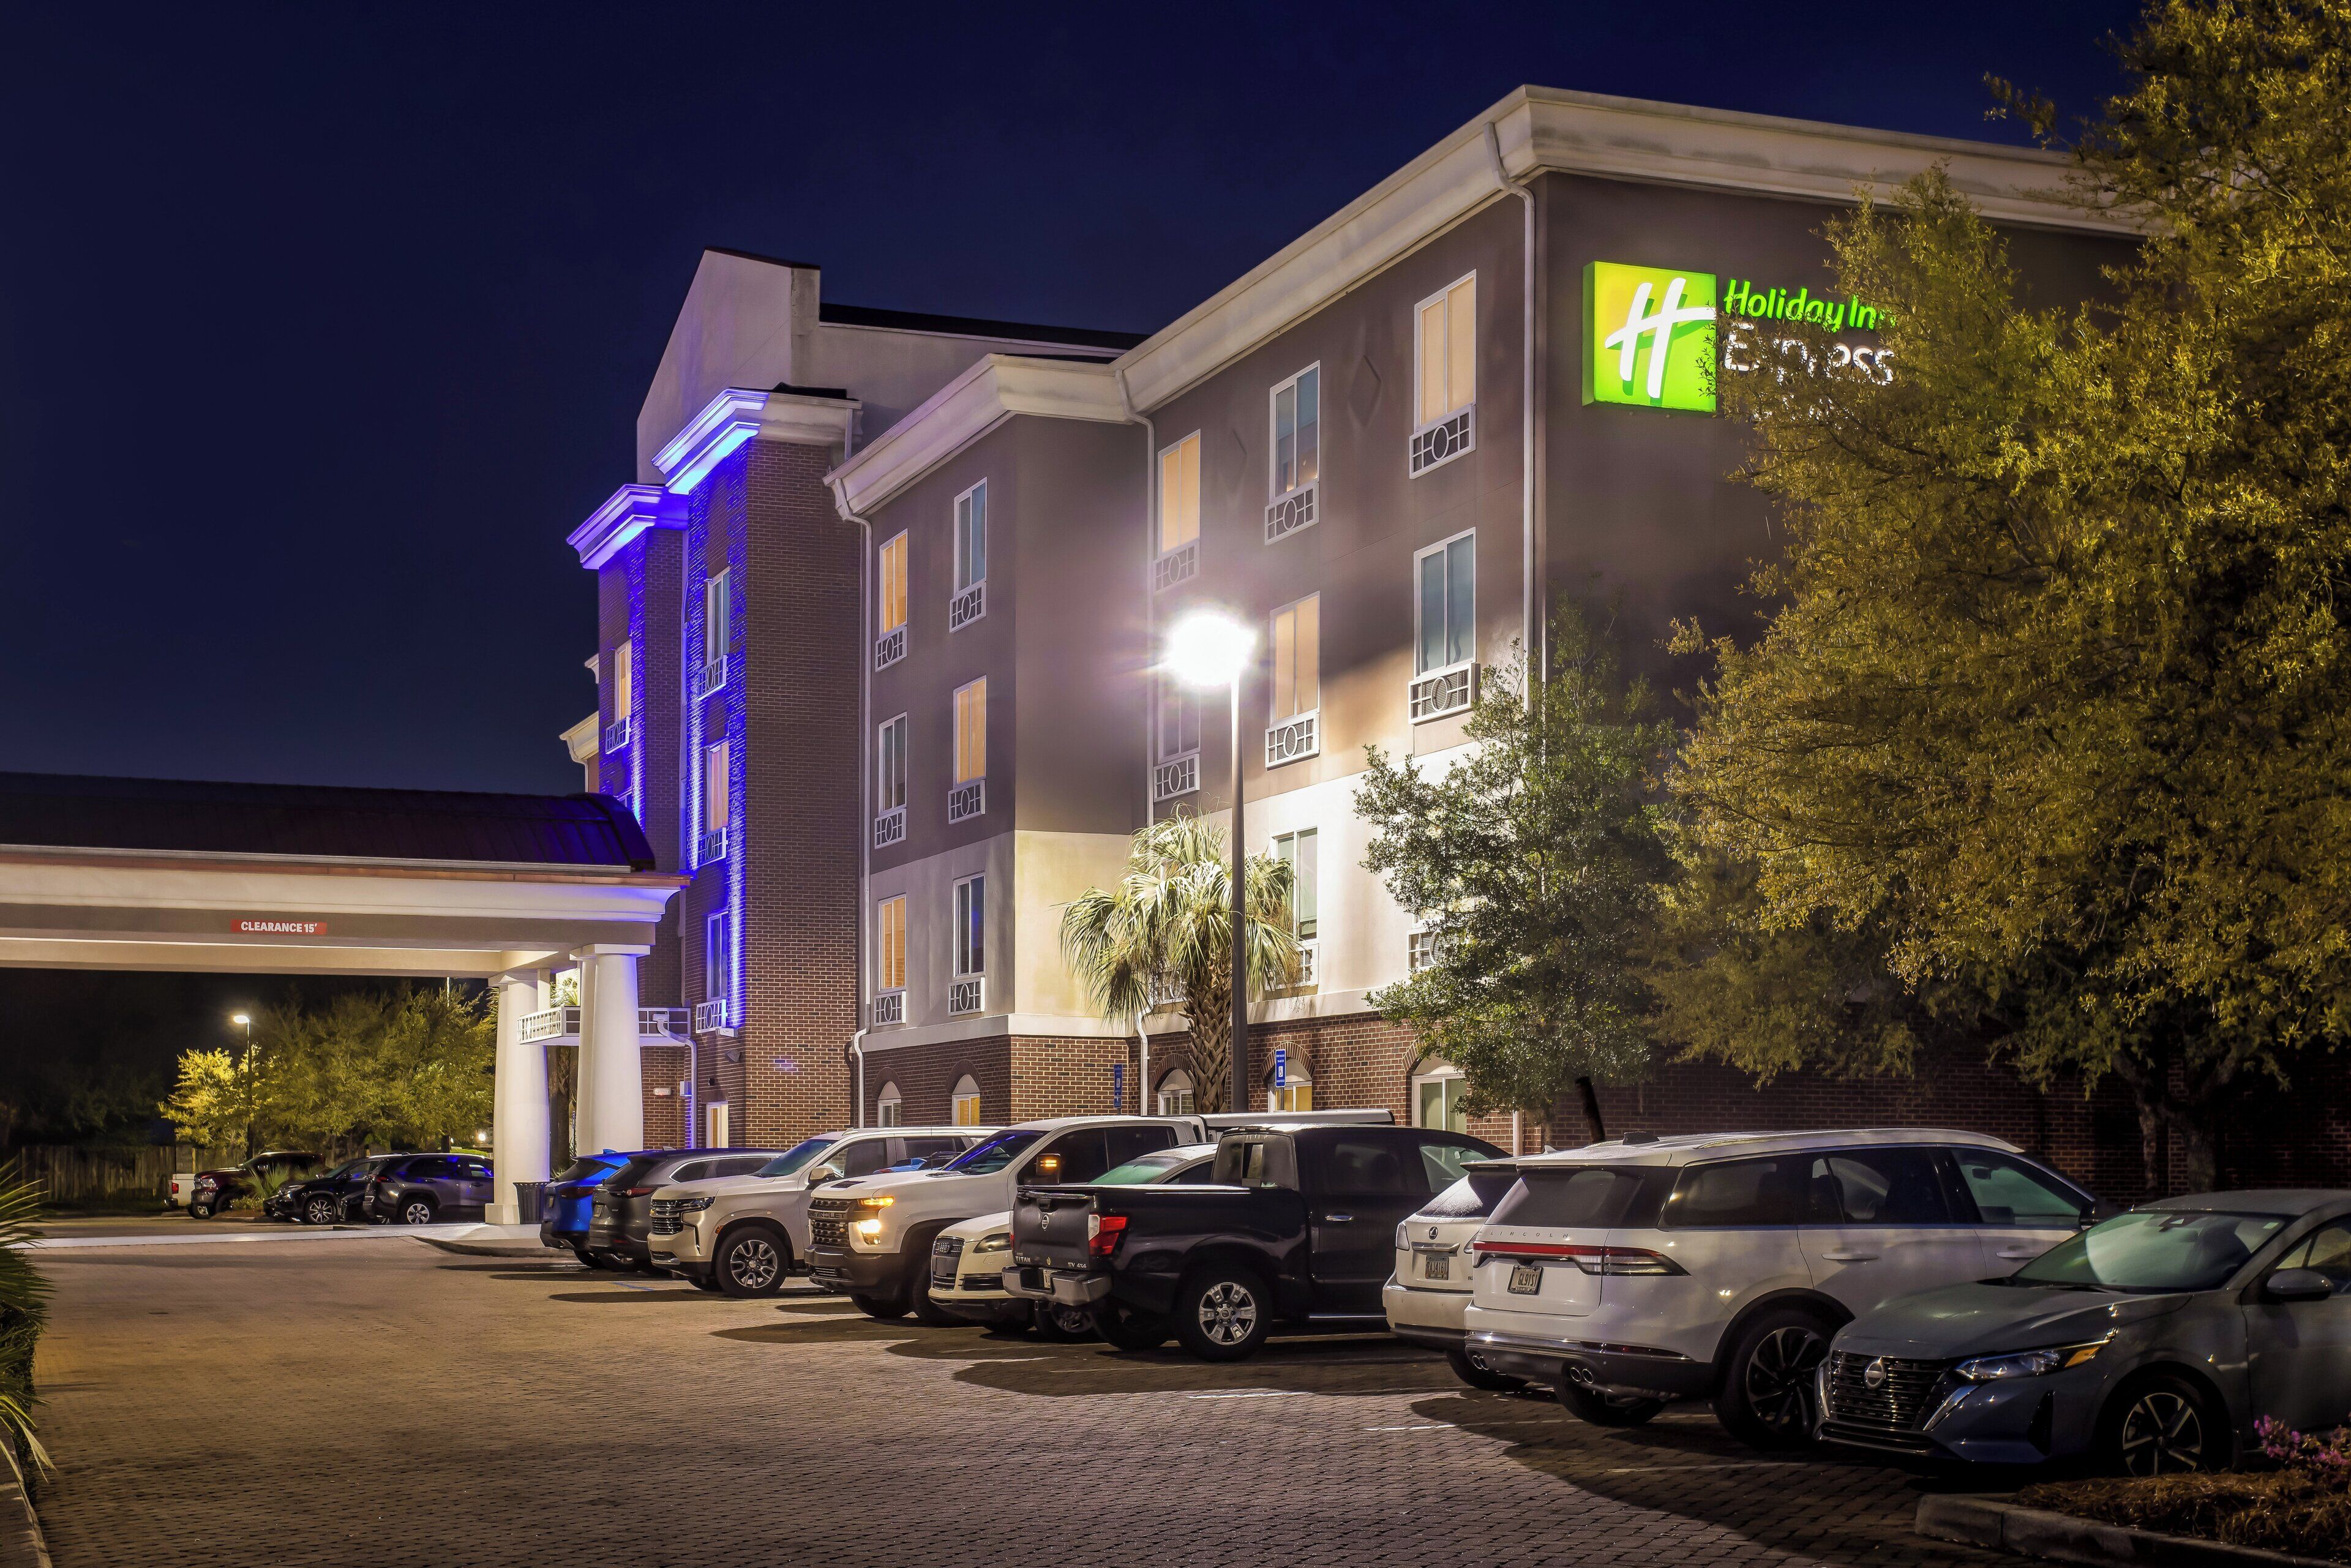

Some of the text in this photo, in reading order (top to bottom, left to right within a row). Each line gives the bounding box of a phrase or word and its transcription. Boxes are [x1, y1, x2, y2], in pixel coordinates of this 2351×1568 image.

[1723, 279, 1845, 333] Holiday
[241, 921, 318, 933] CLEARANCE 15'
